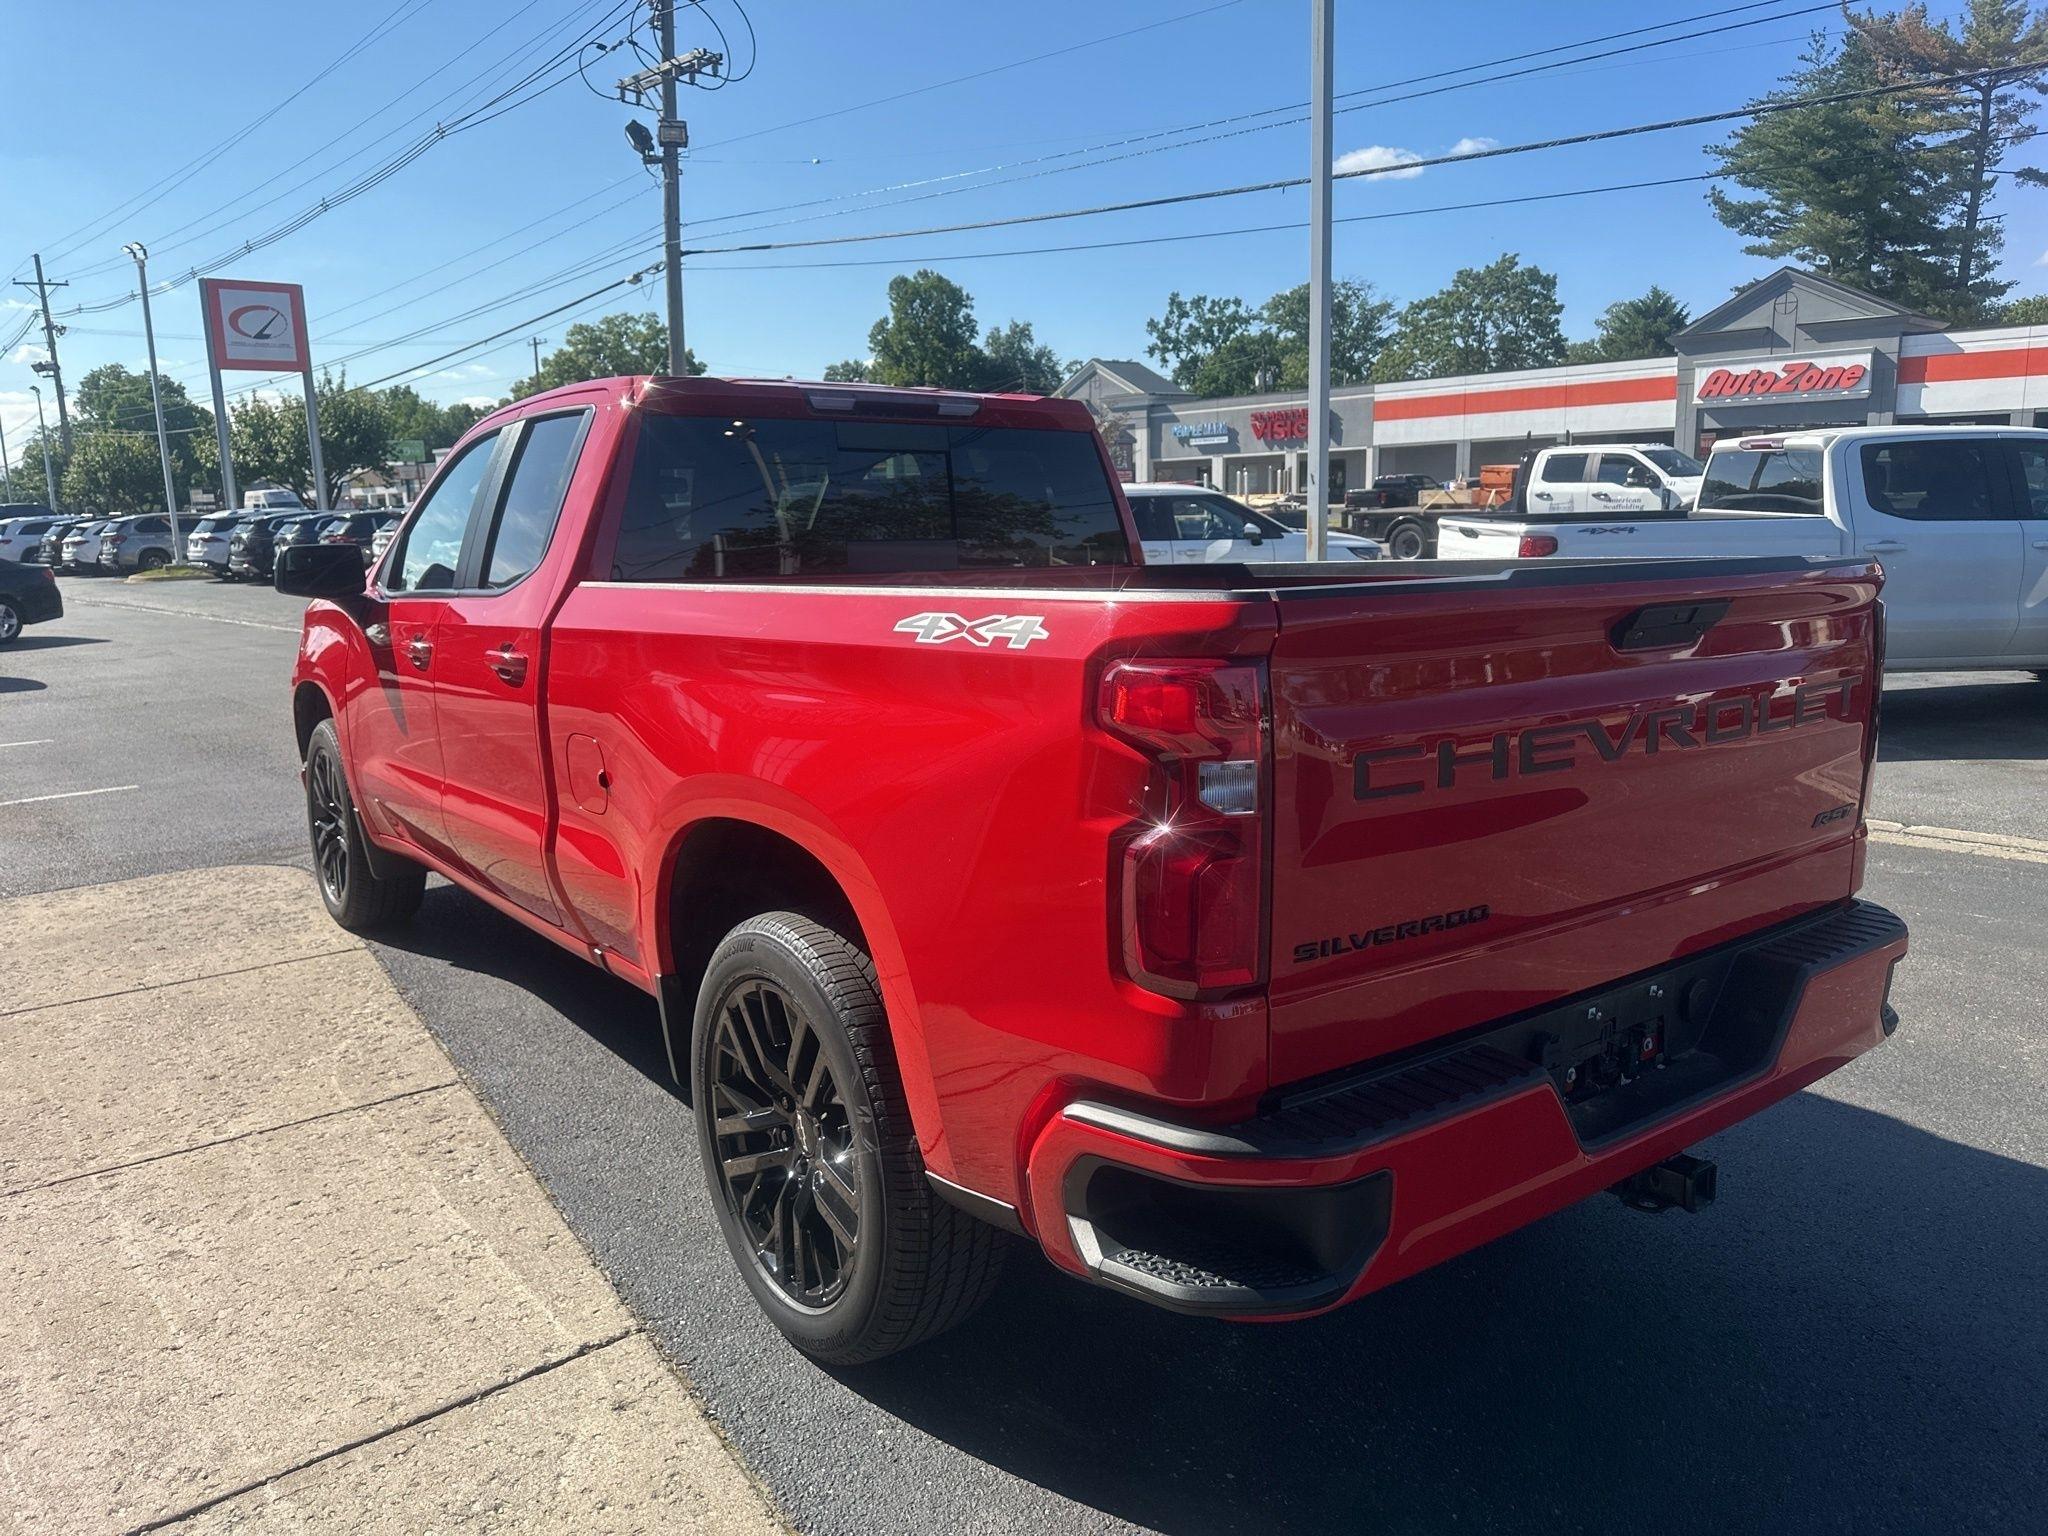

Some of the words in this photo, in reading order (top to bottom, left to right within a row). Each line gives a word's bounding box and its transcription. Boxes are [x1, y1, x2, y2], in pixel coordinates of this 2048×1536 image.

[1697, 361, 1866, 399] AutoZone
[1251, 419, 1308, 440] VISIO
[1352, 674, 1864, 801] CHEVROLET
[1811, 802, 1857, 828] RST
[1292, 903, 1491, 964] SILVERADO
